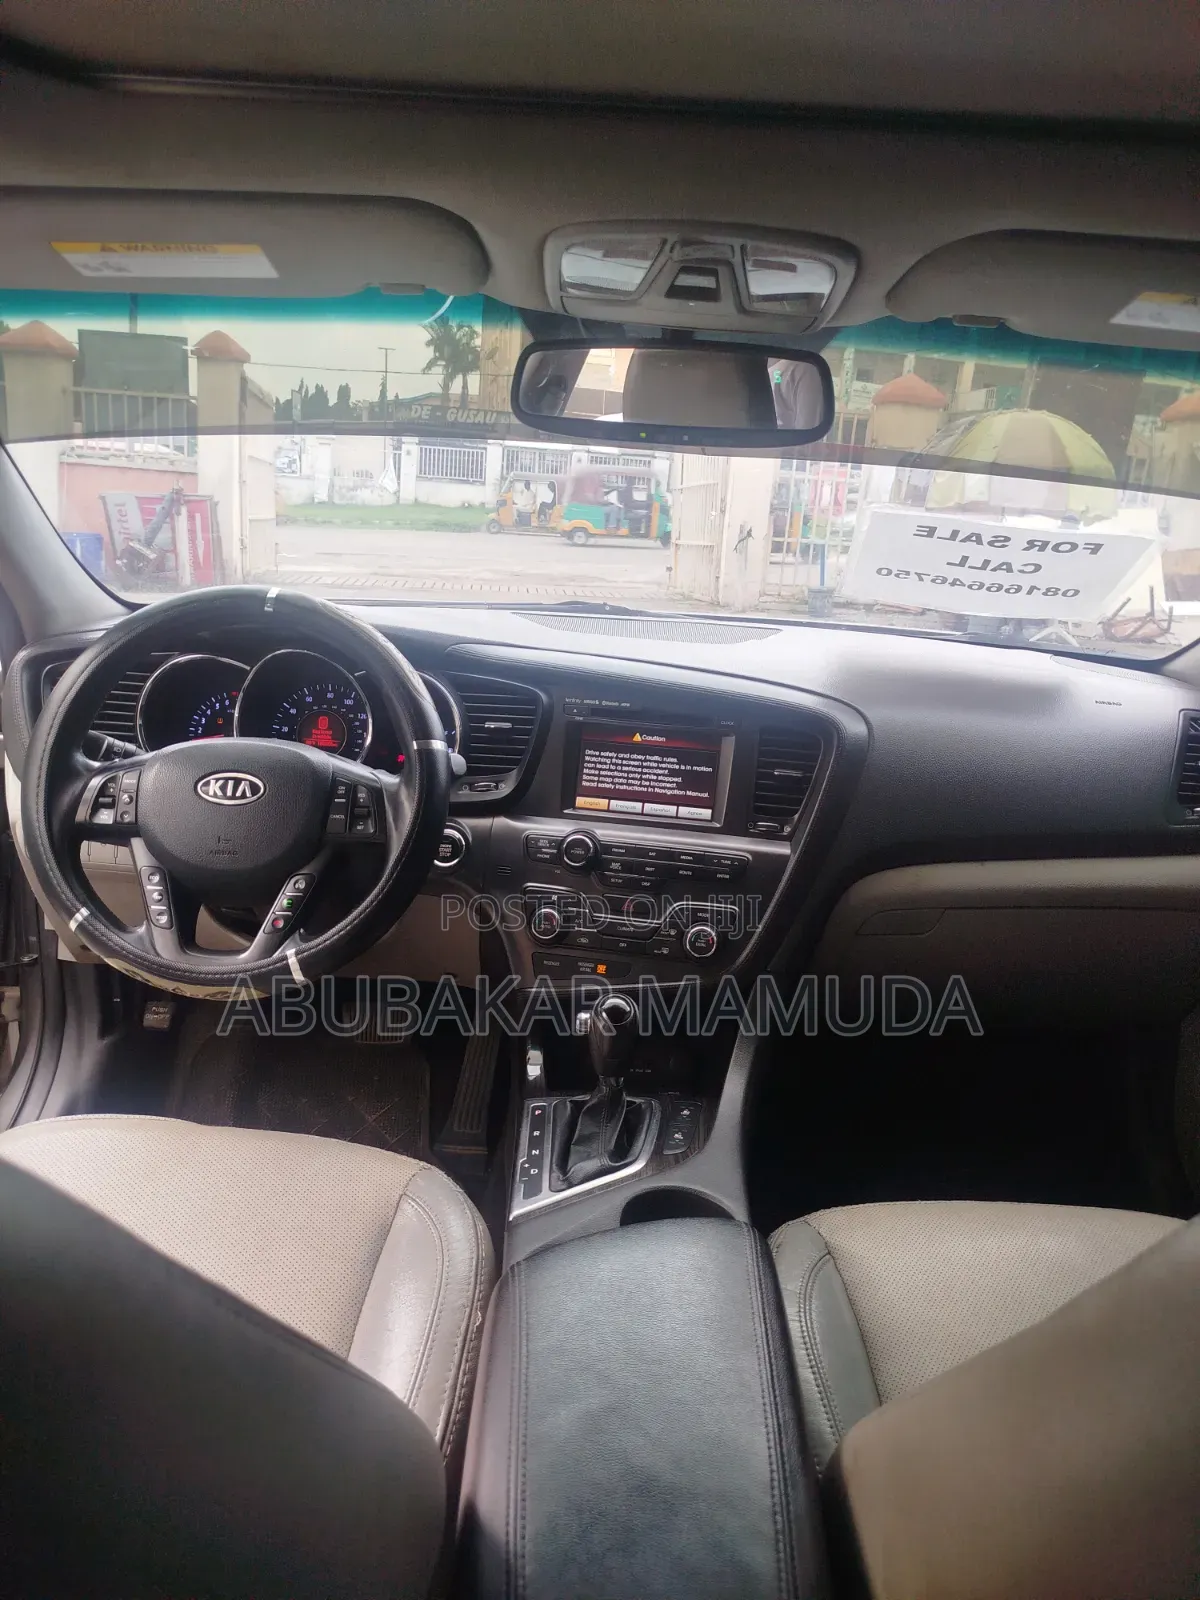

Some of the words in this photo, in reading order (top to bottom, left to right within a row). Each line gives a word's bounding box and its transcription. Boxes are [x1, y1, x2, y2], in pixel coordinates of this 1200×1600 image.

[446, 408, 497, 424] GUSAU
[641, 734, 666, 742] Caution
[584, 755, 611, 764] Watching
[642, 767, 670, 775] accident.
[657, 775, 683, 783] stopped.
[208, 778, 254, 798] KIA
[615, 784, 648, 792] instructions
[654, 787, 686, 796] Navigation
[686, 790, 710, 798] Manual.
